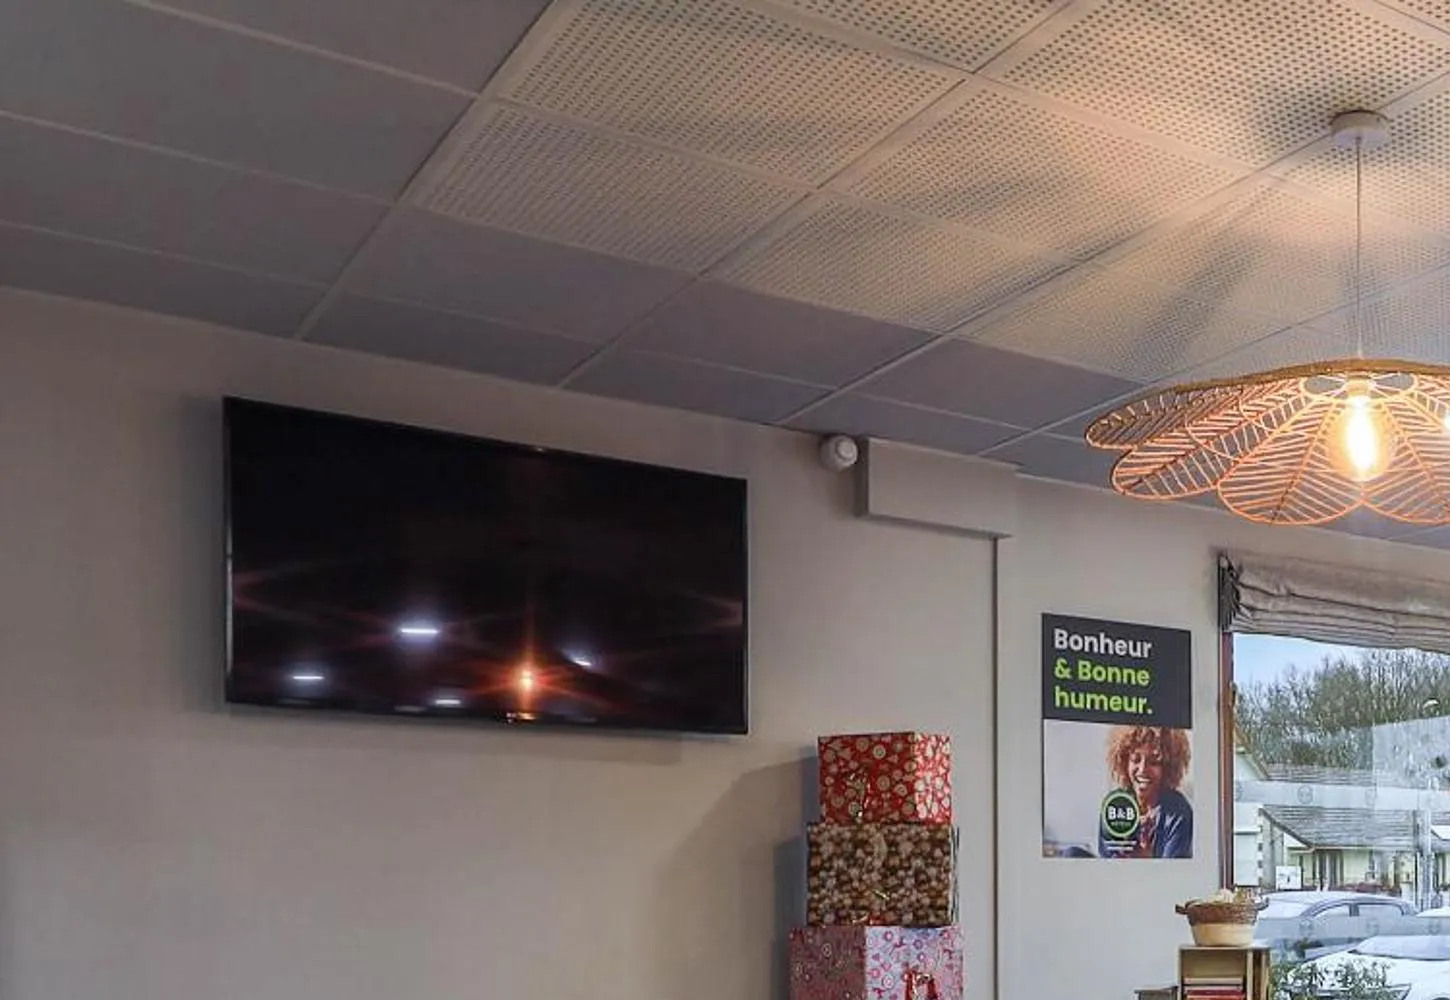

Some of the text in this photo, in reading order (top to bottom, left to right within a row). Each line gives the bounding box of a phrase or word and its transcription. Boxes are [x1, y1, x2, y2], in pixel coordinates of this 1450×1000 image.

[1054, 628, 1152, 658] Bonheur
[1054, 658, 1150, 686] & Bonne
[1055, 685, 1153, 714] humeur.
[1107, 806, 1135, 820] B&B
